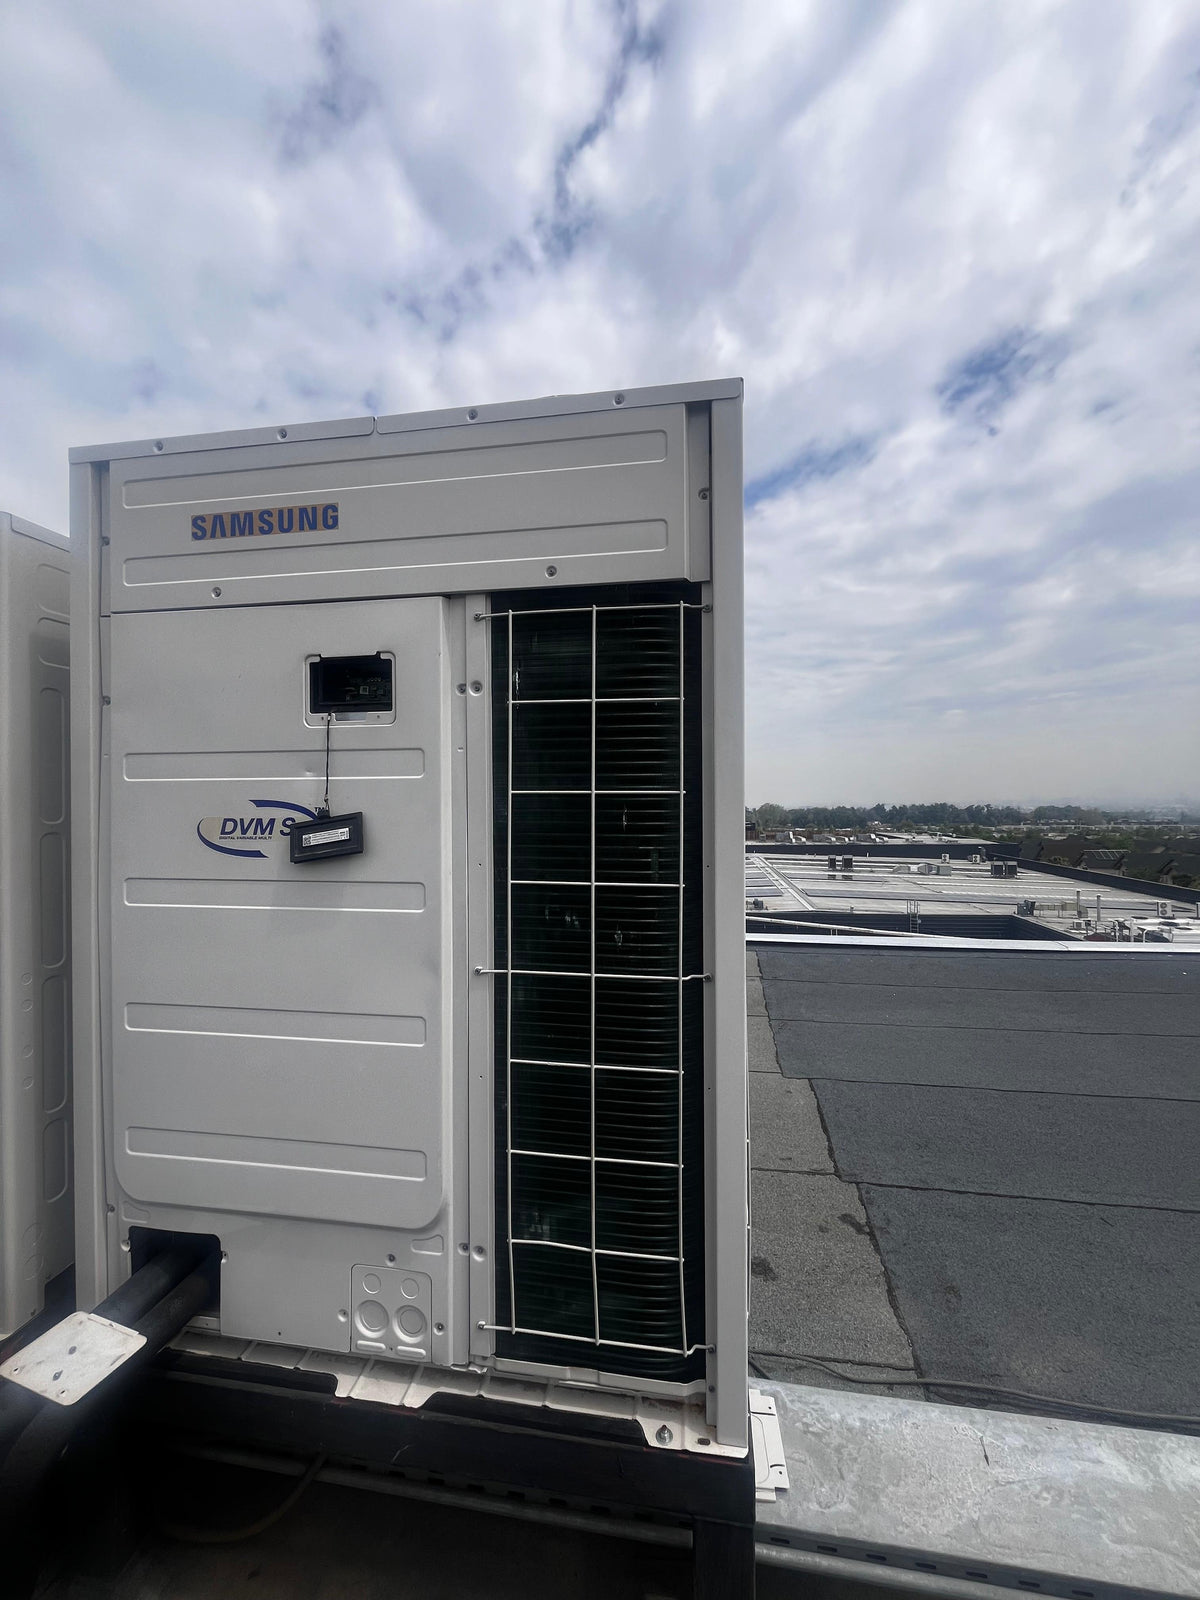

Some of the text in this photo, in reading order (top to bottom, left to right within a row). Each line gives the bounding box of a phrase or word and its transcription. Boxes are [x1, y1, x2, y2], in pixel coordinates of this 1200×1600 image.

[192, 505, 338, 540] SAMSUNG
[220, 817, 296, 836] DVM S
